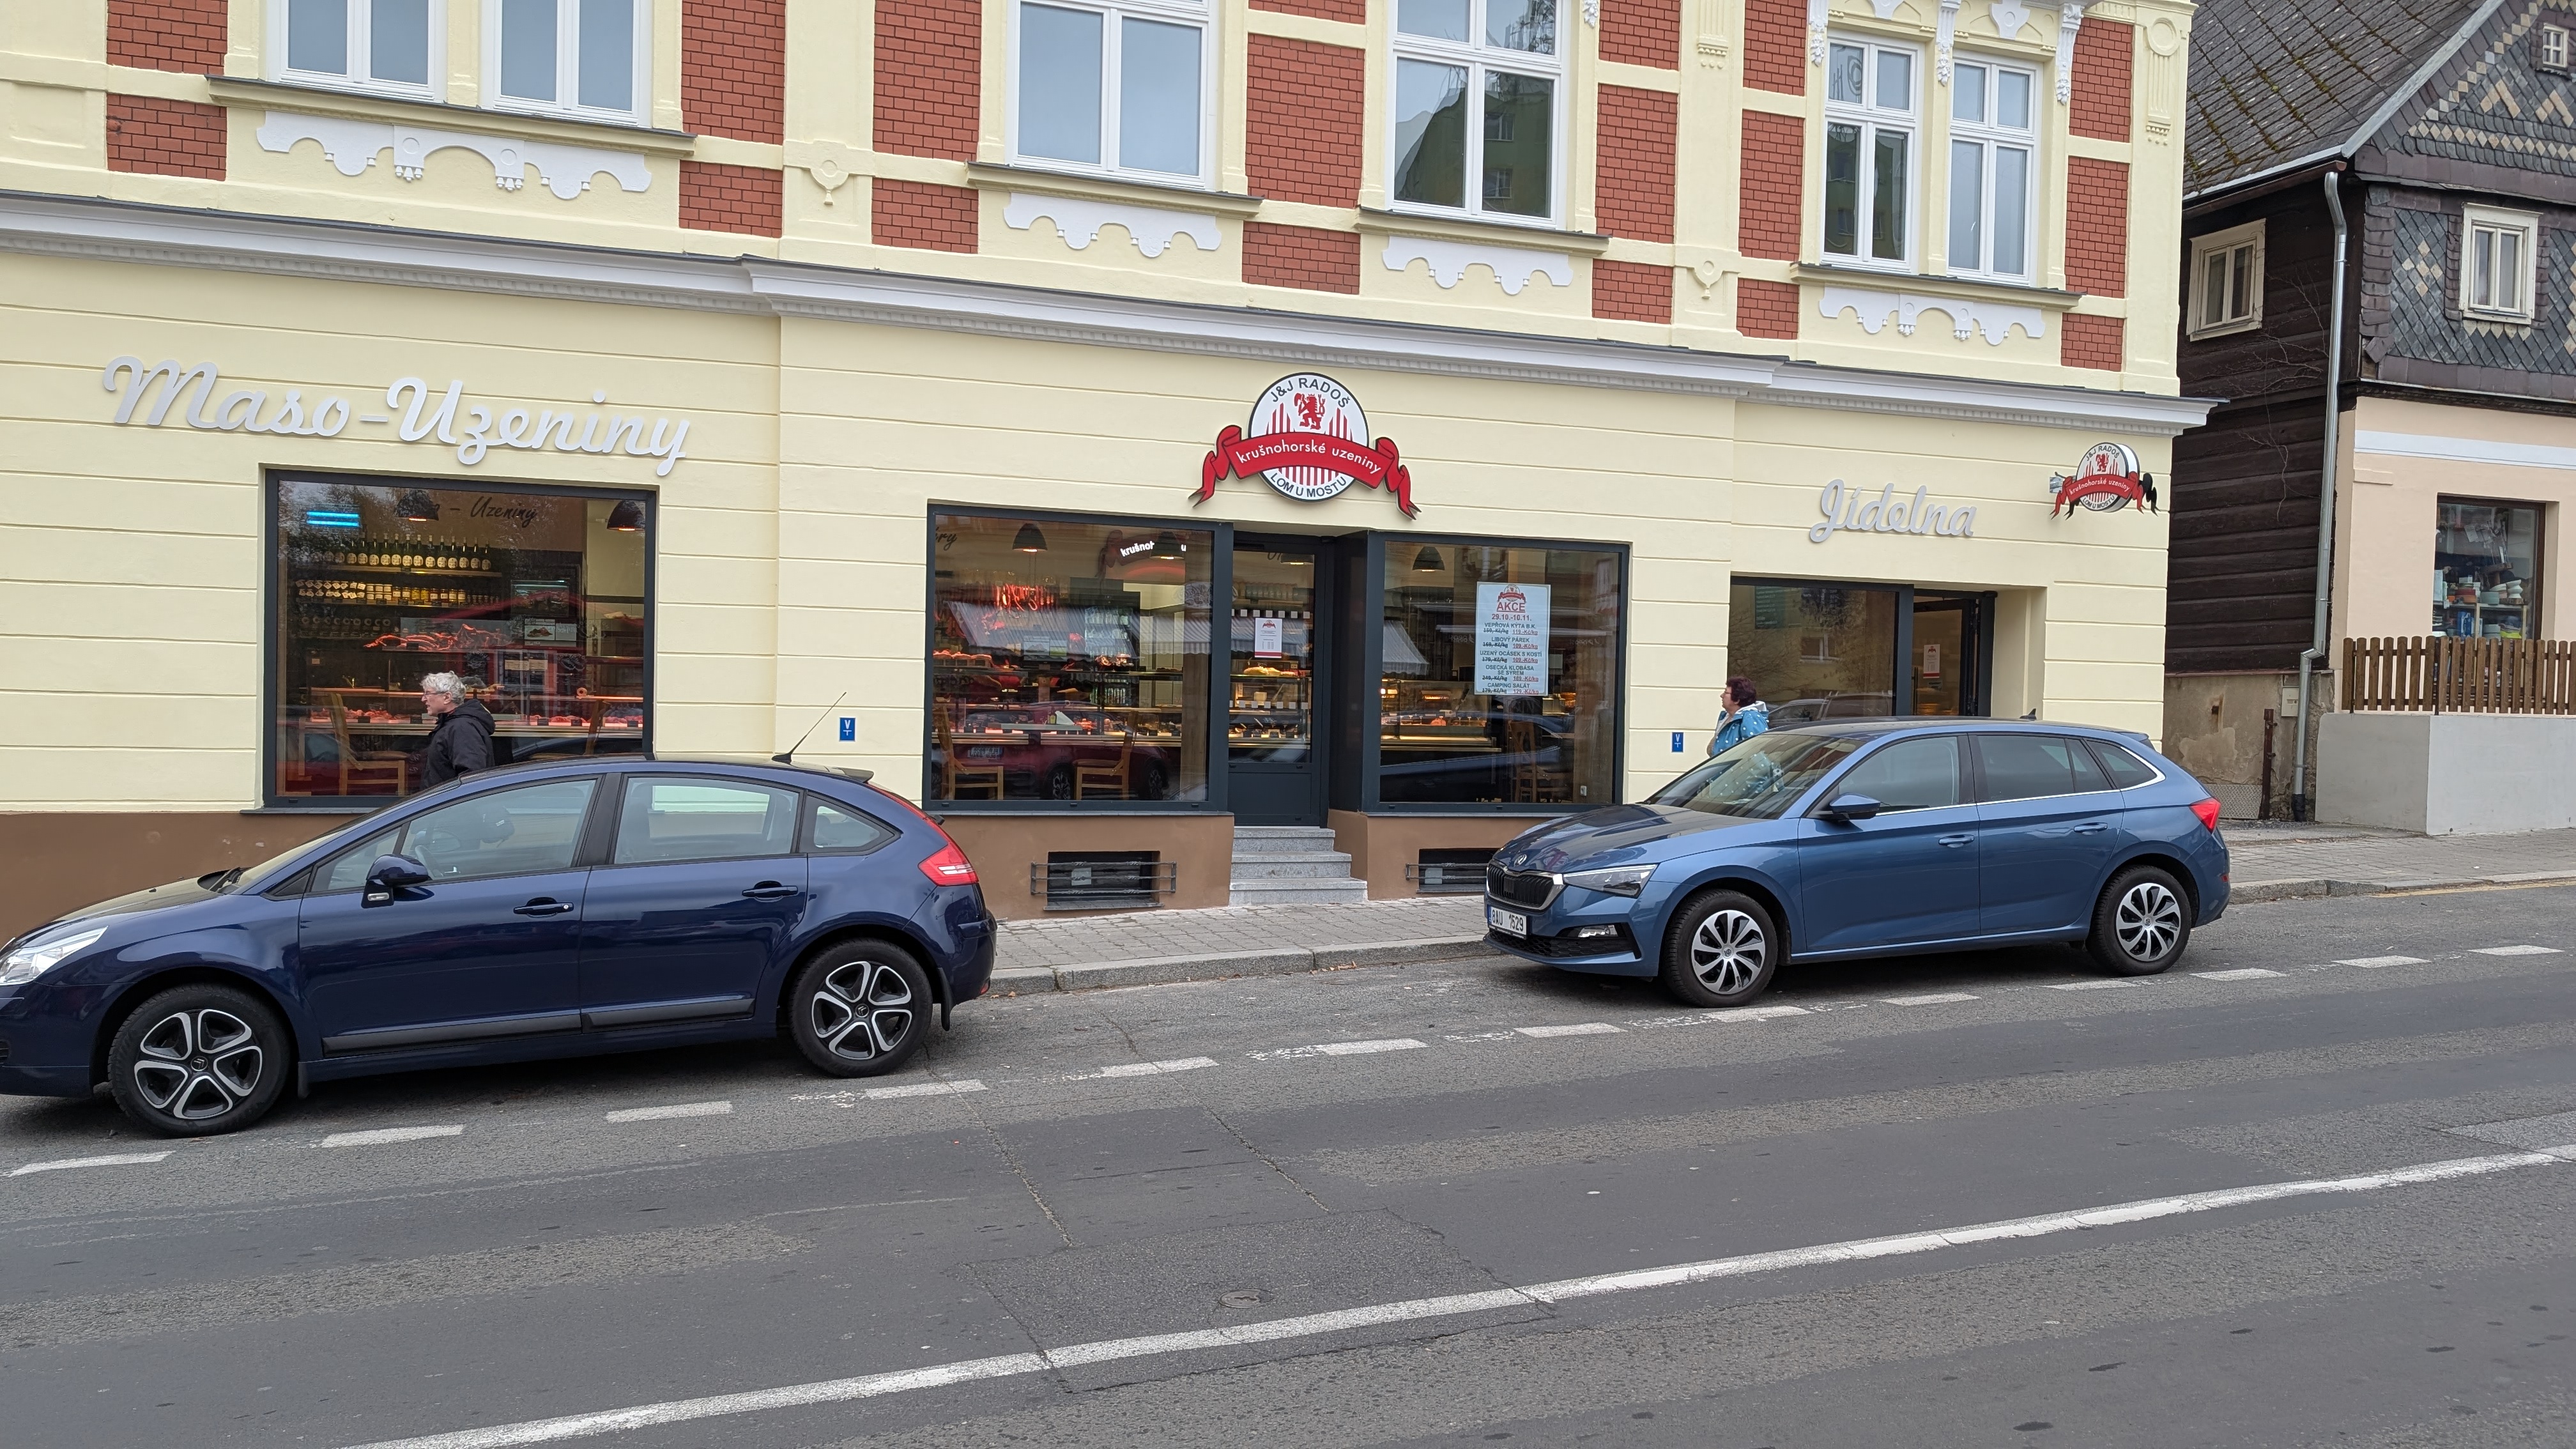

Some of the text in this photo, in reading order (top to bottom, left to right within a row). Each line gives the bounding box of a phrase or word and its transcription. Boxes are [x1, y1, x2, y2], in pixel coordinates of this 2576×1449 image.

[1270, 378, 1351, 408] J&J RADOŠ
[1236, 440, 1381, 474] krušnohorské uzeniny
[2086, 445, 2120, 461] J&J RADOŠ
[1270, 472, 1347, 498] LOM U MOSTU
[2069, 477, 2131, 495] krušnohorské uzeniny
[471, 496, 537, 528] Uzeniny
[1809, 479, 1977, 542] Jídelna
[2082, 497, 2092, 508] LOM
[2097, 495, 2115, 509] MOSTU
[1497, 602, 1526, 612] AKCE
[1492, 909, 1523, 931] 8AU 1529
